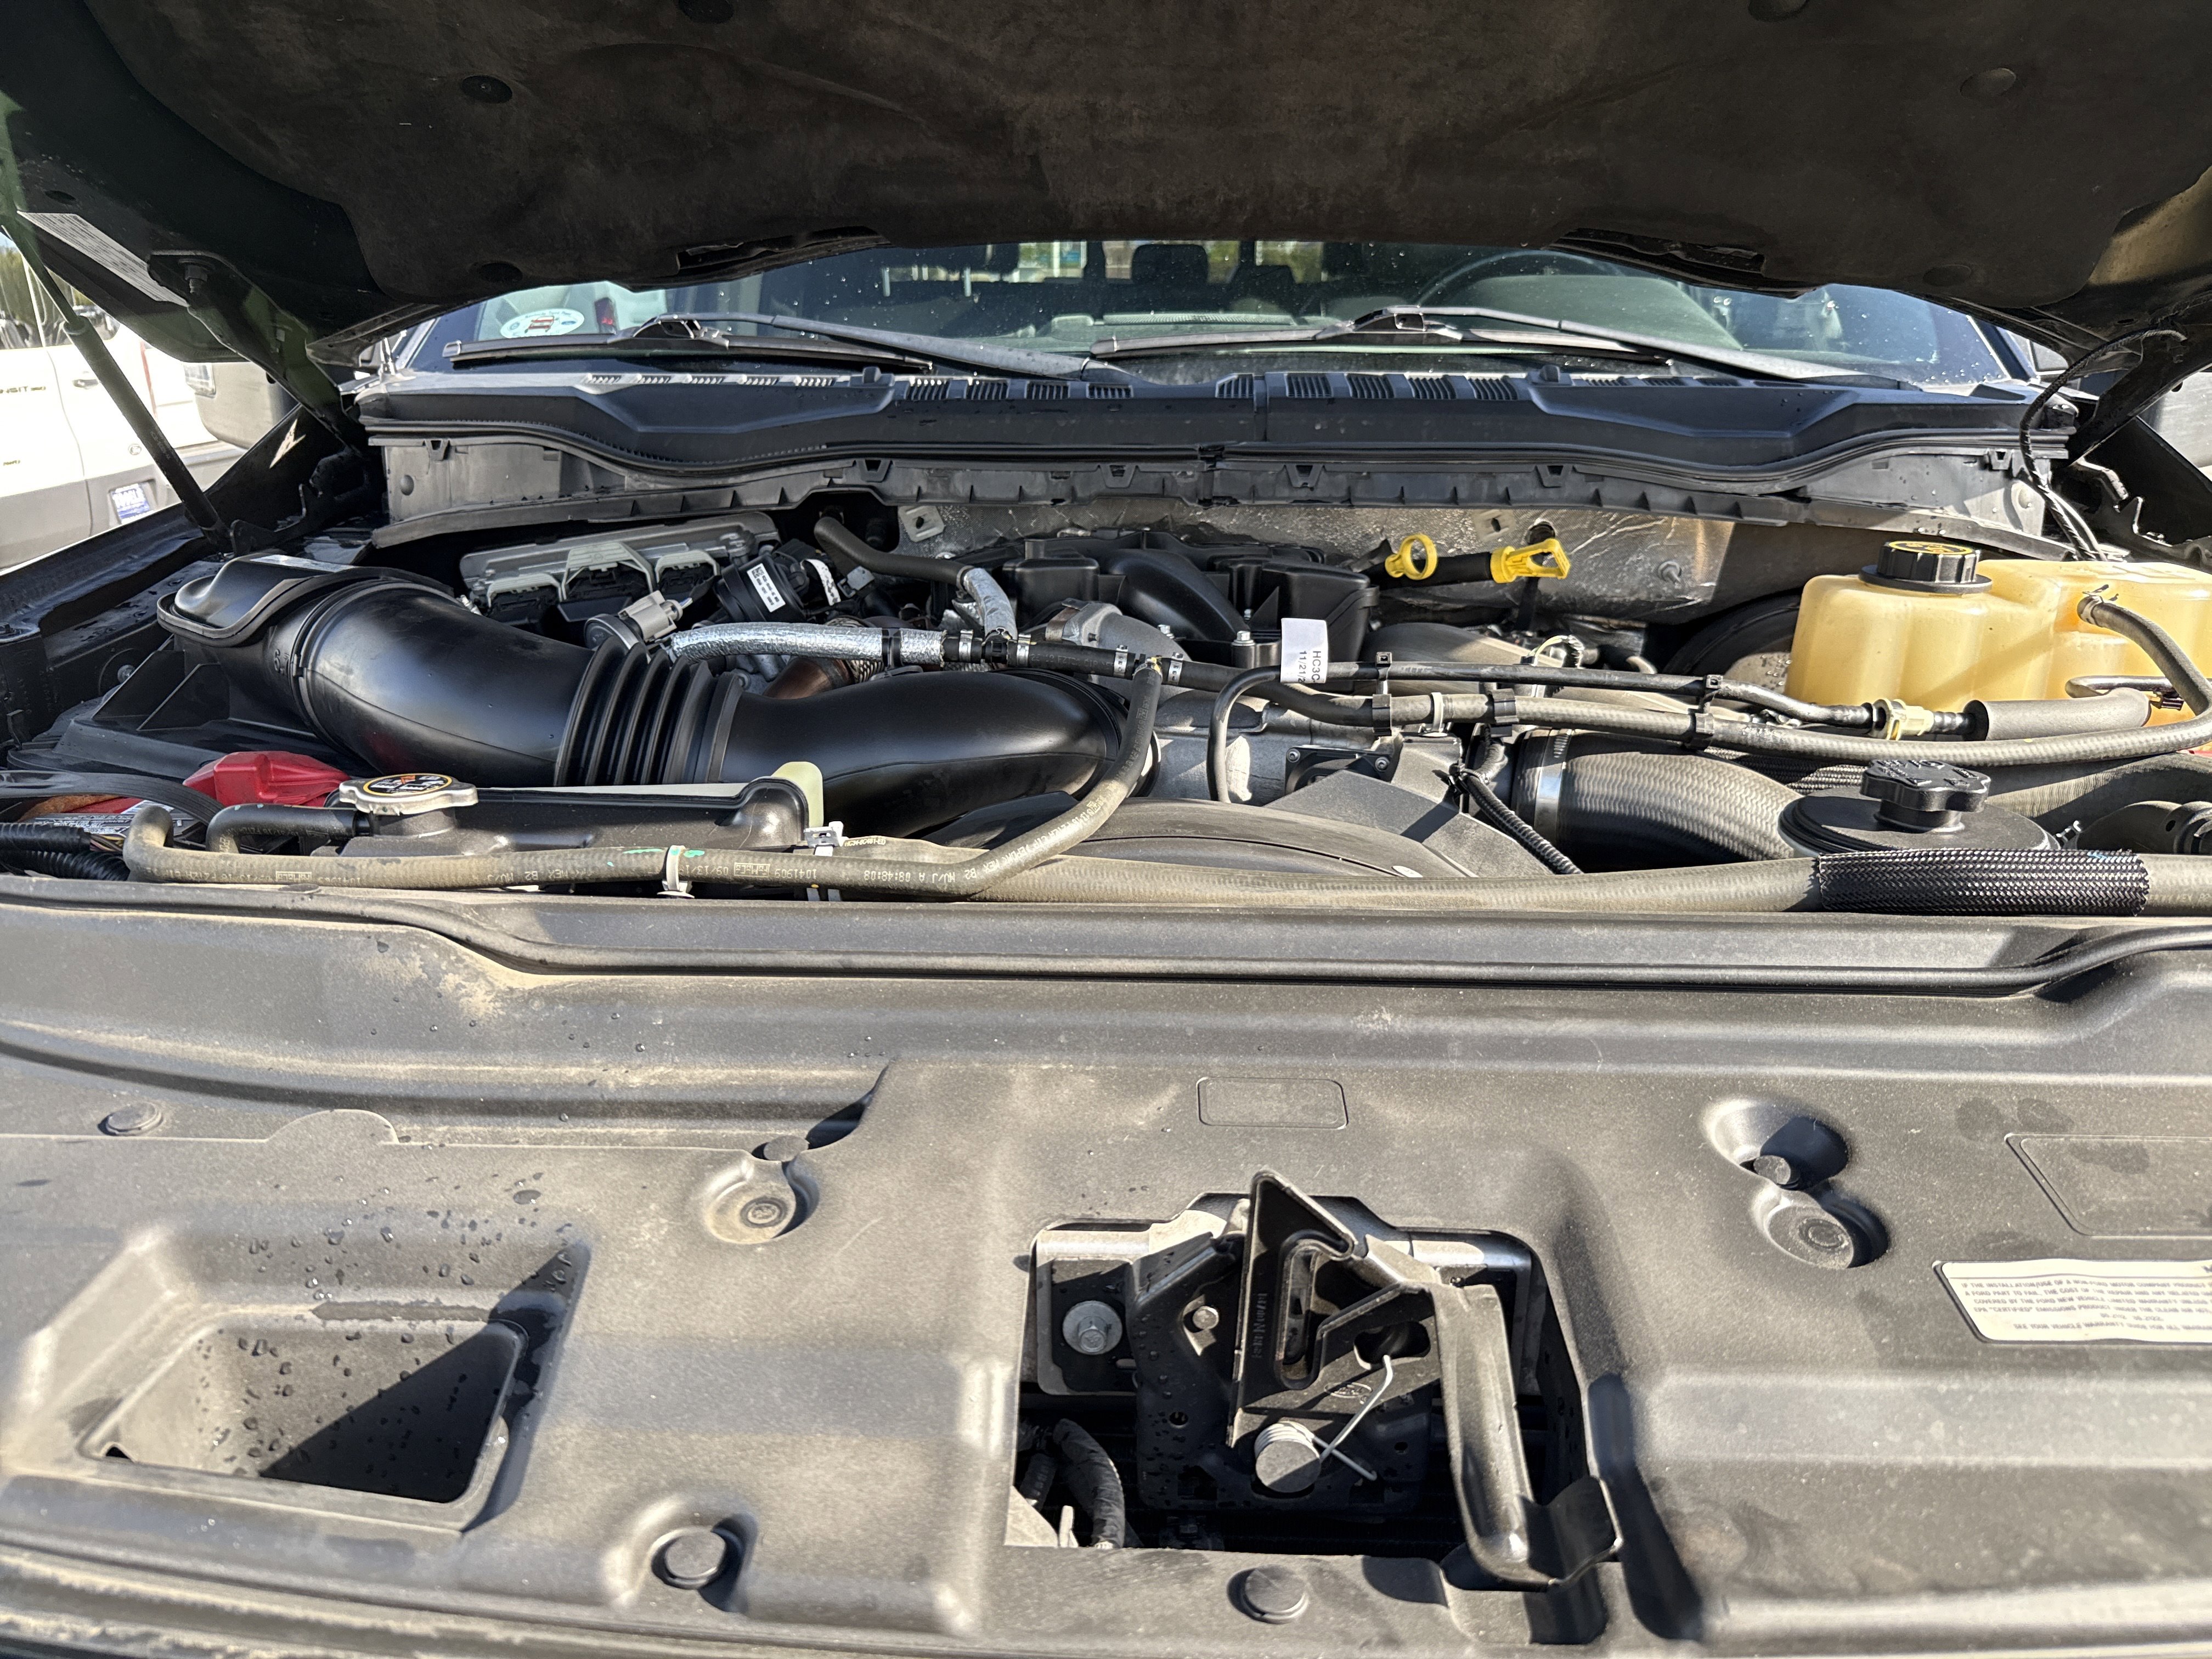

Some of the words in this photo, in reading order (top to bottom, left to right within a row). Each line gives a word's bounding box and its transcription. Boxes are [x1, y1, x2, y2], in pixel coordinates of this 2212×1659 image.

[524, 870, 538, 881] B2
[774, 868, 817, 879] 1041909
[918, 872, 926, 882] A
